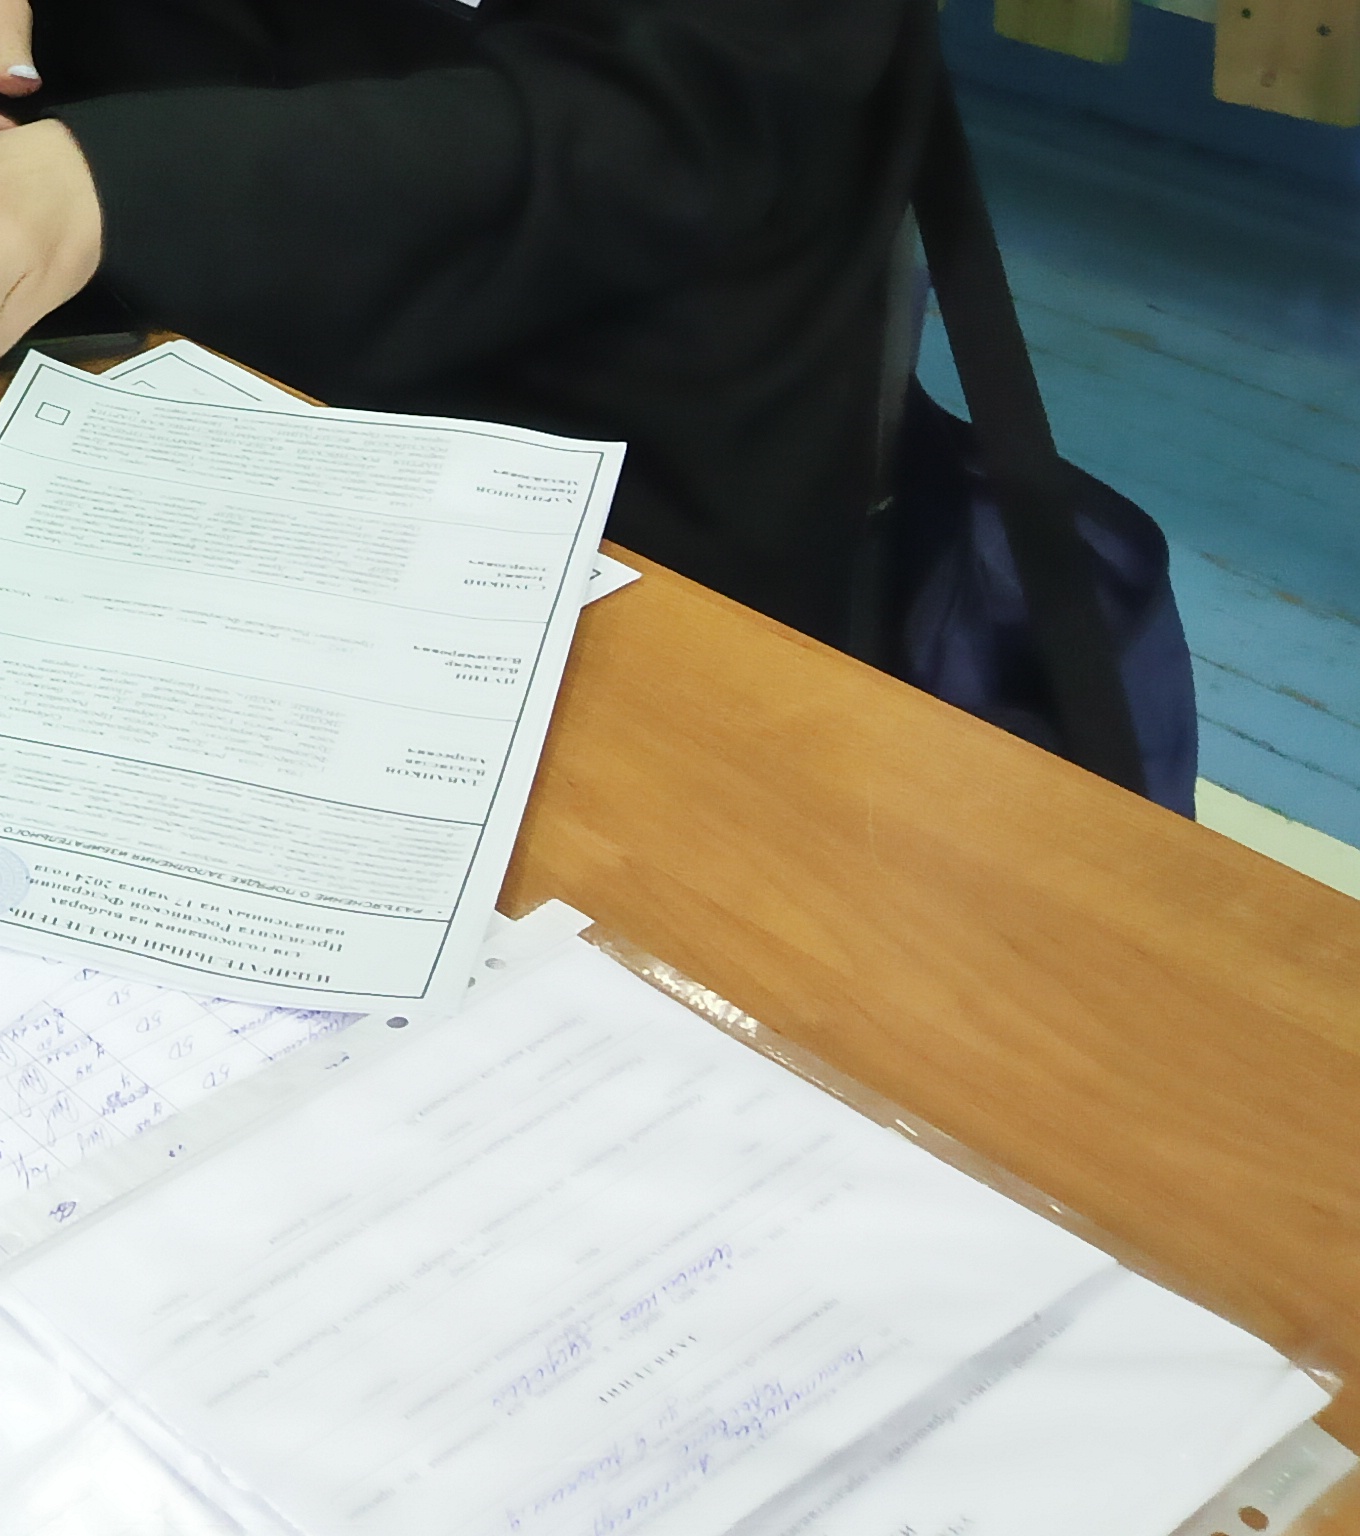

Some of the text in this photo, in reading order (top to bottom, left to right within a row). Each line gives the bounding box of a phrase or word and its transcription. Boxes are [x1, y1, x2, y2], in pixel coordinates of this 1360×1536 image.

[0, 824, 129, 859] ИЗБИРАТЕЛЬНОГО
[32, 862, 70, 878] года
[129, 852, 225, 880] ЗАПОЛНЕНИЯ
[73, 872, 113, 889] 2024
[116, 881, 169, 901] марта
[227, 873, 297, 896] ПОРЯДКЕ
[47, 894, 123, 920] выборах
[129, 899, 232, 933] Российской
[173, 897, 193, 909] 17
[225, 907, 345, 937] назначенных
[6, 905, 331, 984] ИЗБИРАТЕЛЬНЫЙ БЮЛЛЕТЕНЬ
[153, 920, 267, 953] голосования
[236, 925, 344, 953] Президента
